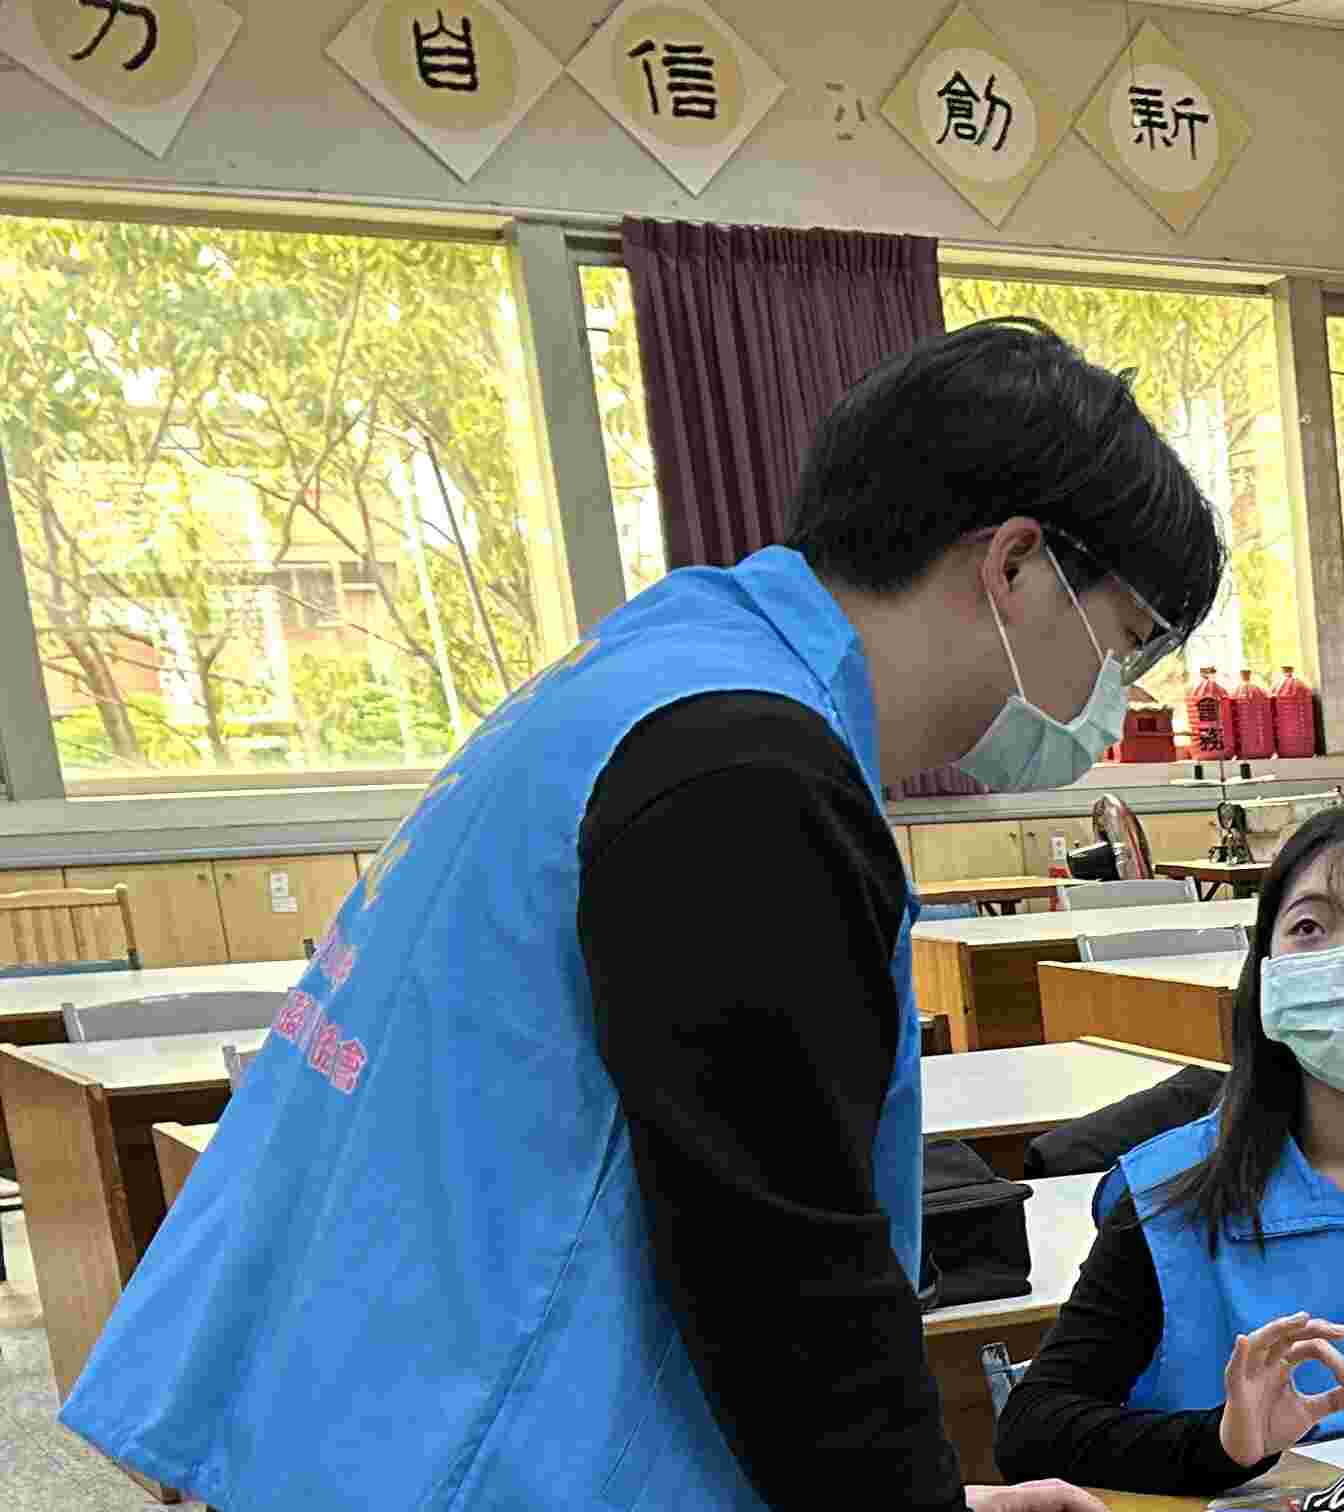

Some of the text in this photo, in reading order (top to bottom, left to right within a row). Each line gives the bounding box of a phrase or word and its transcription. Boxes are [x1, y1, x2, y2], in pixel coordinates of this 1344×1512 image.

[628, 39, 717, 119] 信
[936, 70, 1012, 151] 創
[1128, 86, 1209, 160] 新
